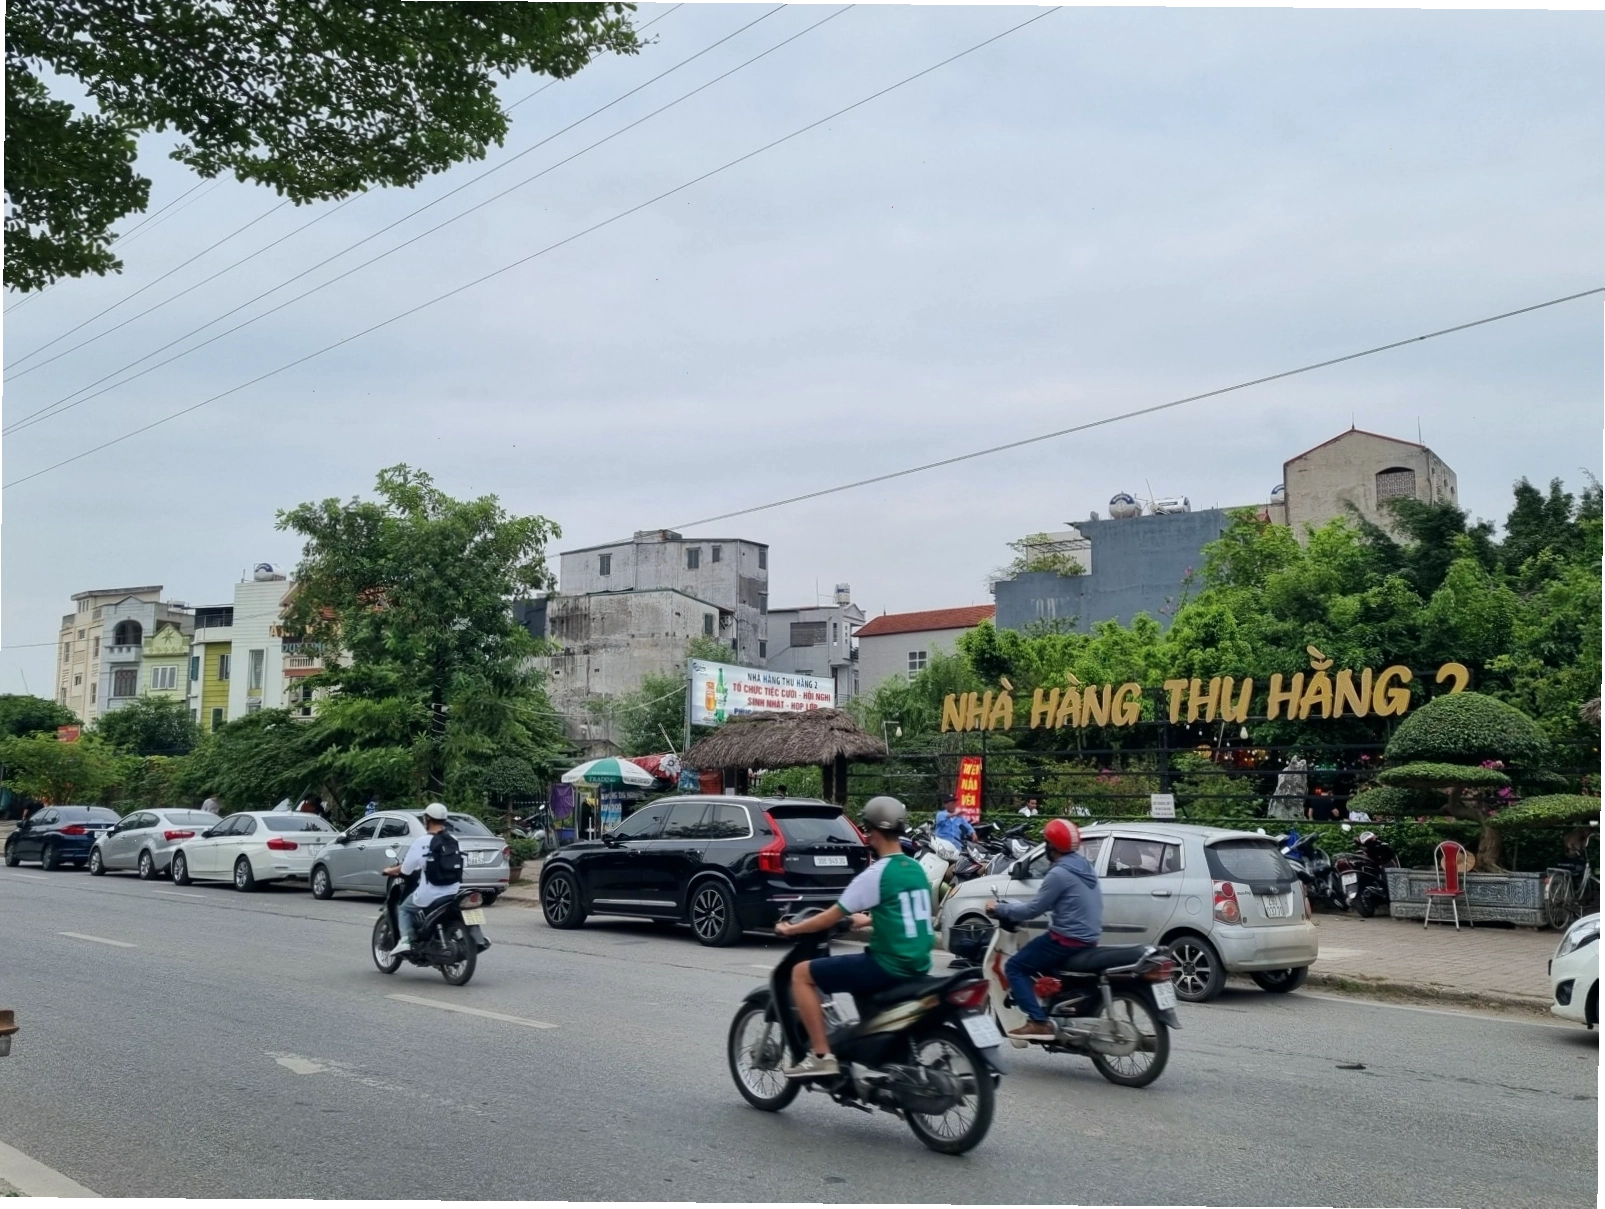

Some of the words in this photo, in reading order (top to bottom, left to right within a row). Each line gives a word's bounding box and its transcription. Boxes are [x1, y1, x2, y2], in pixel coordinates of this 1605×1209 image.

[747, 671, 761, 682] NHÀ
[763, 673, 781, 686] HÀNG
[782, 676, 795, 687] THU
[814, 681, 818, 690] 2
[941, 677, 1014, 733] NHÀ
[1030, 672, 1142, 730] HÀNG
[1163, 676, 1254, 724] THU
[1266, 645, 1413, 721] HẰNG
[1435, 662, 1470, 695] 2
[764, 685, 780, 698] TIỆC
[747, 697, 765, 707] SINH
[897, 888, 934, 939] 14
